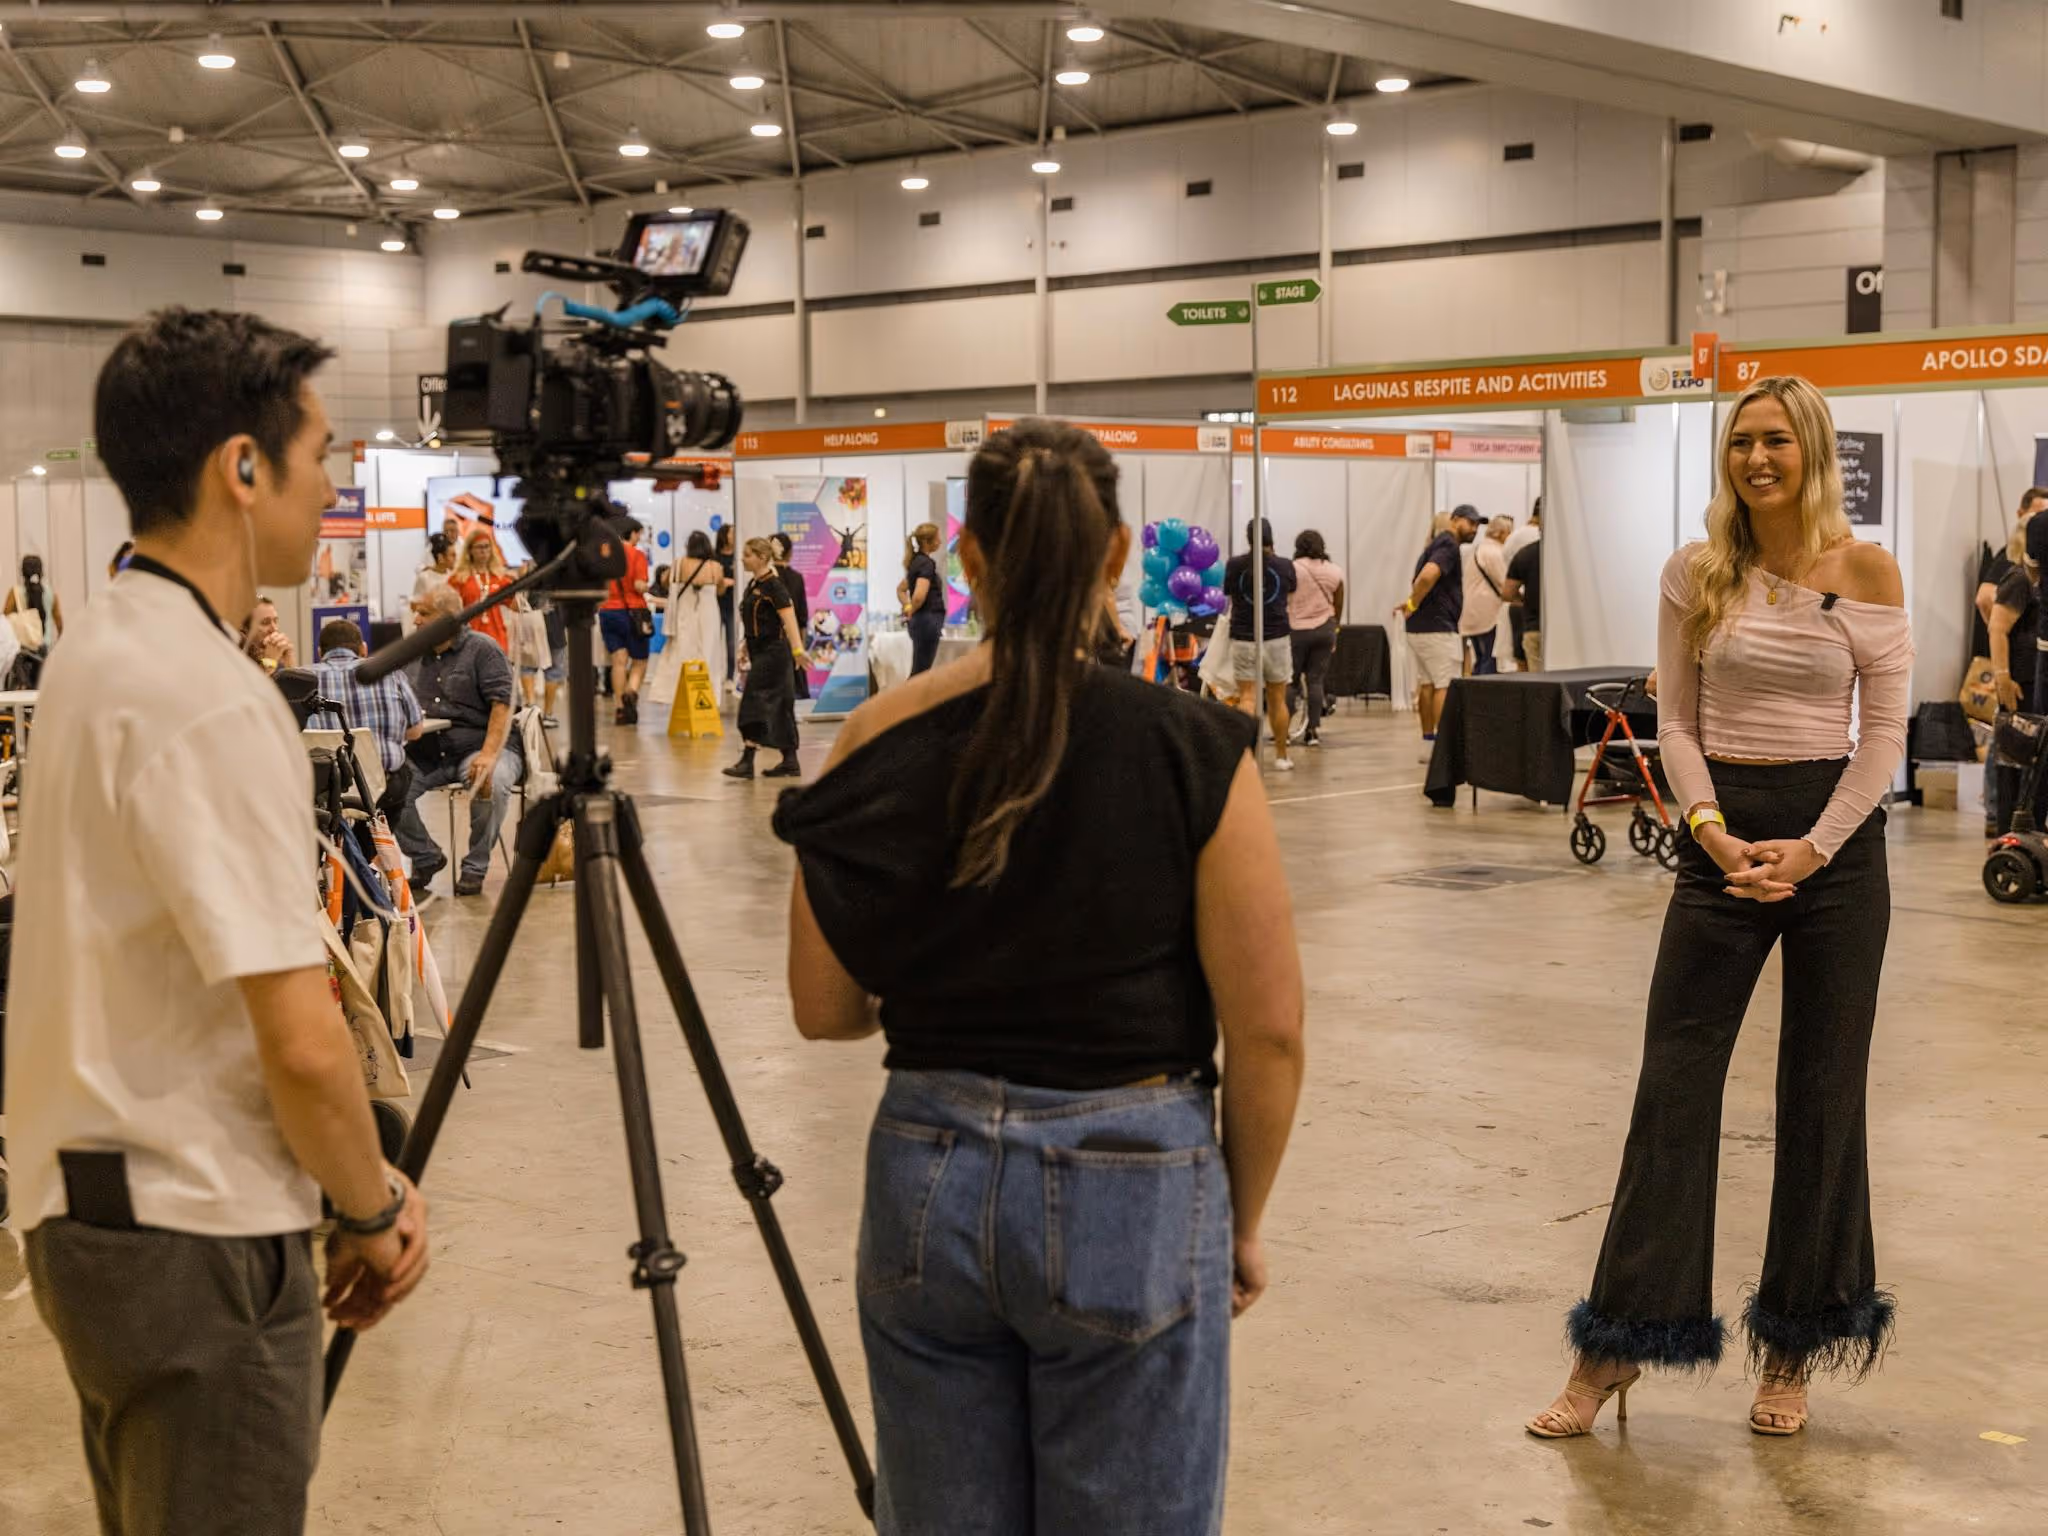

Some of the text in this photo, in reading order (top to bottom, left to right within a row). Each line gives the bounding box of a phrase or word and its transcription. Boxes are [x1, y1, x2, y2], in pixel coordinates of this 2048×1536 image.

[1275, 286, 1306, 300] STAGE
[1181, 307, 1227, 320] TOILETS
[1921, 347, 2008, 371] APOLLO
[1737, 361, 1761, 381] 87
[1271, 369, 1608, 404] 112 LAGUNAS RESPITE AND ACTIVITIES
[1672, 378, 1704, 389] EXPO
[823, 431, 879, 447] HELPALONG
